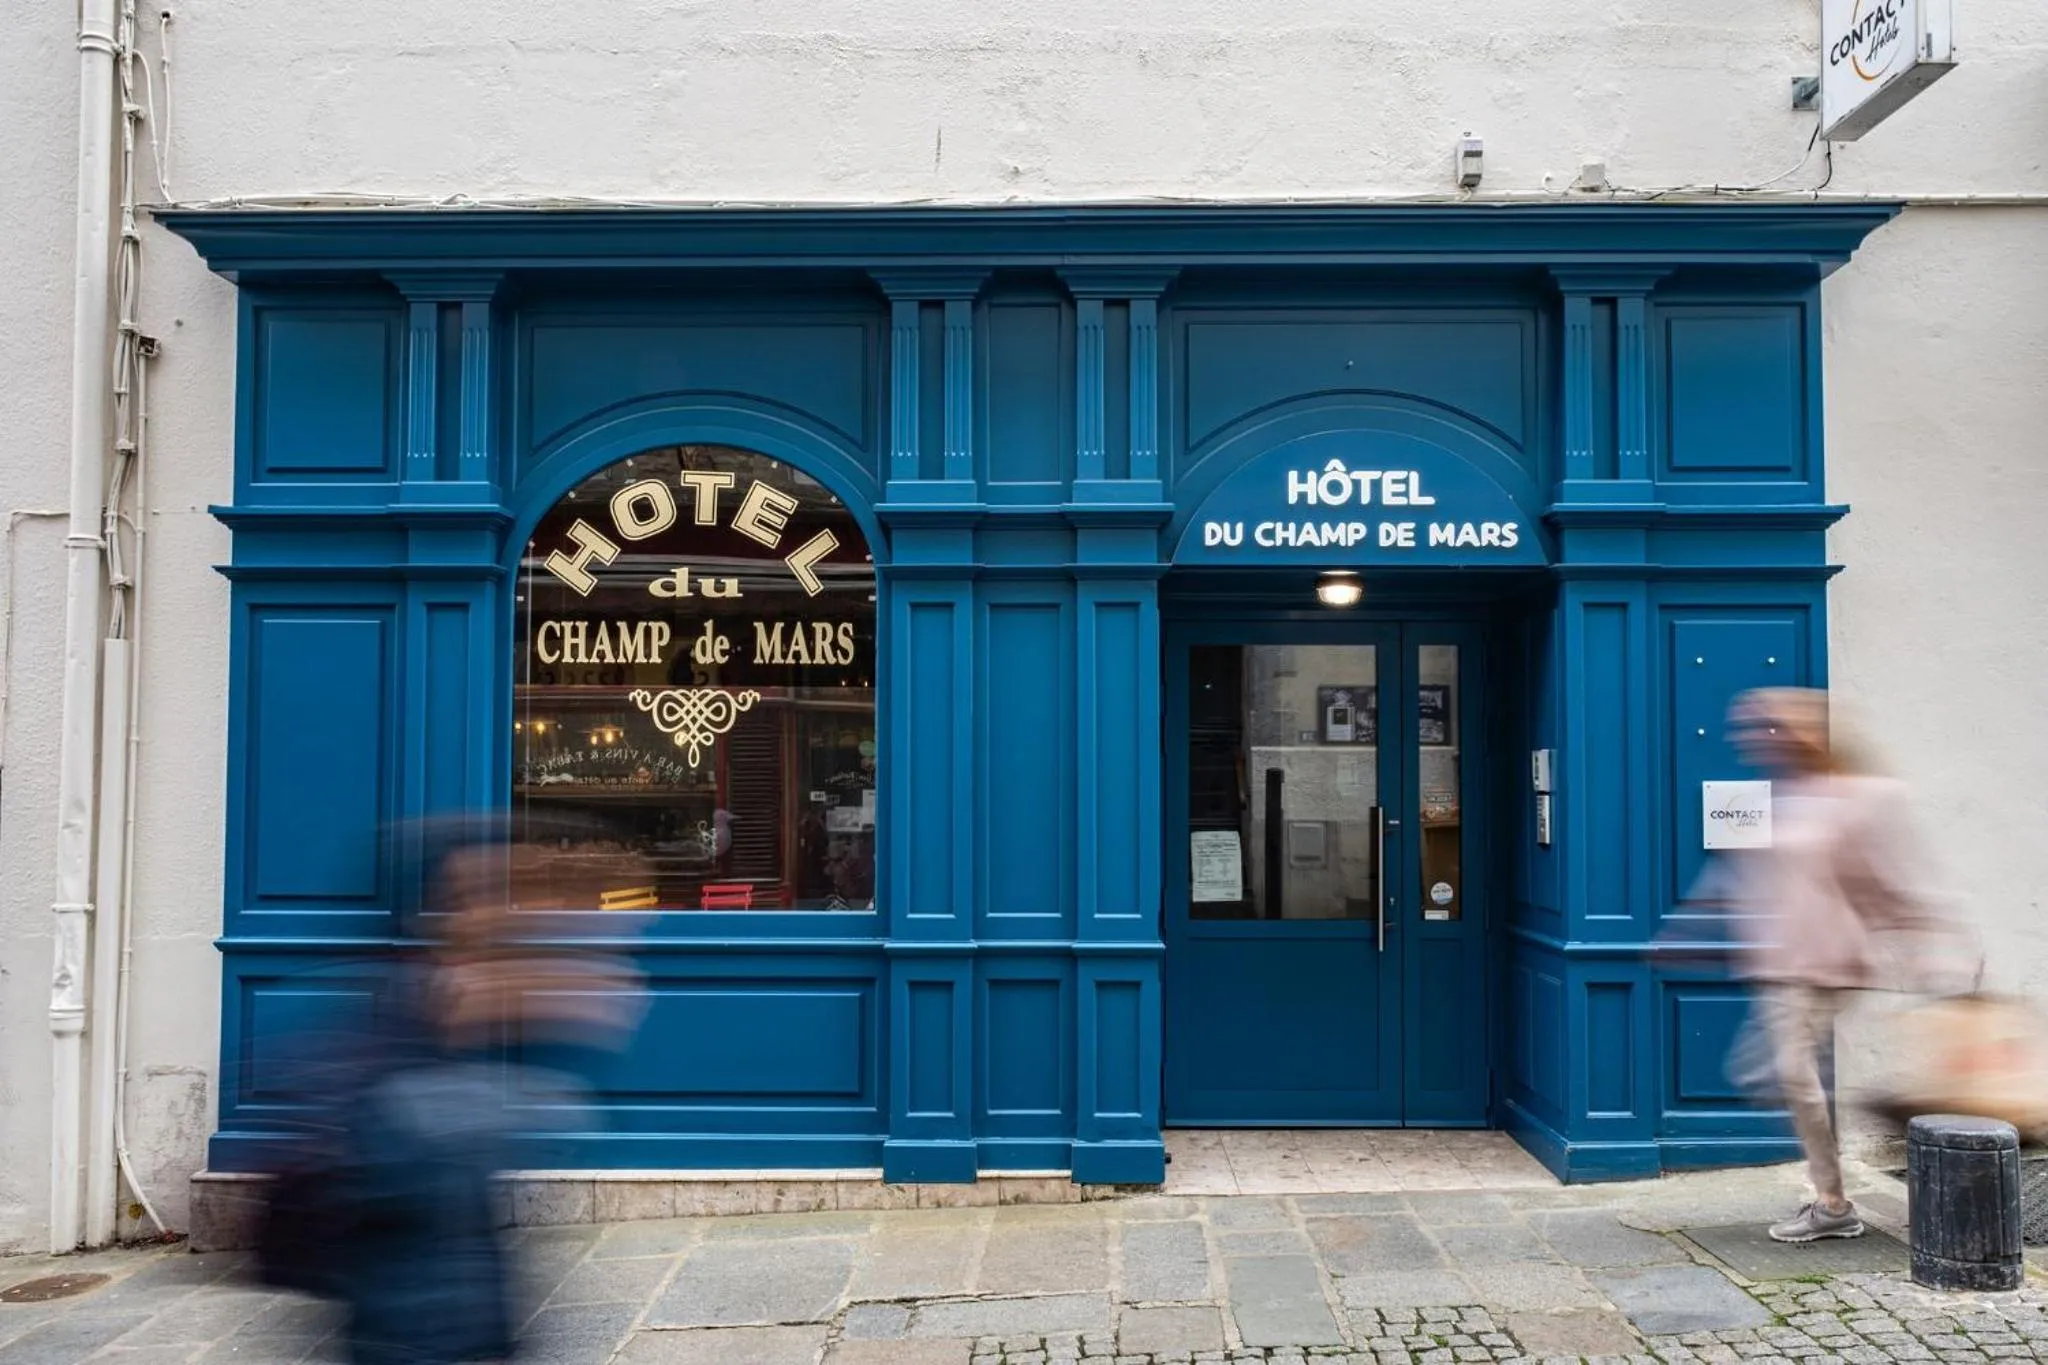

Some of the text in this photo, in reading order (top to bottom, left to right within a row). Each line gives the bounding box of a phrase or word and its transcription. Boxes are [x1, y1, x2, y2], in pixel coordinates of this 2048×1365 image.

[1288, 458, 1436, 506] HÔTEL
[544, 470, 839, 597] HOTEL
[1204, 521, 1519, 548] DU CHAMP DE MARS
[648, 567, 743, 598] du
[537, 619, 854, 665] CHAMP de MARS
[1710, 810, 1764, 820] CONTACT
